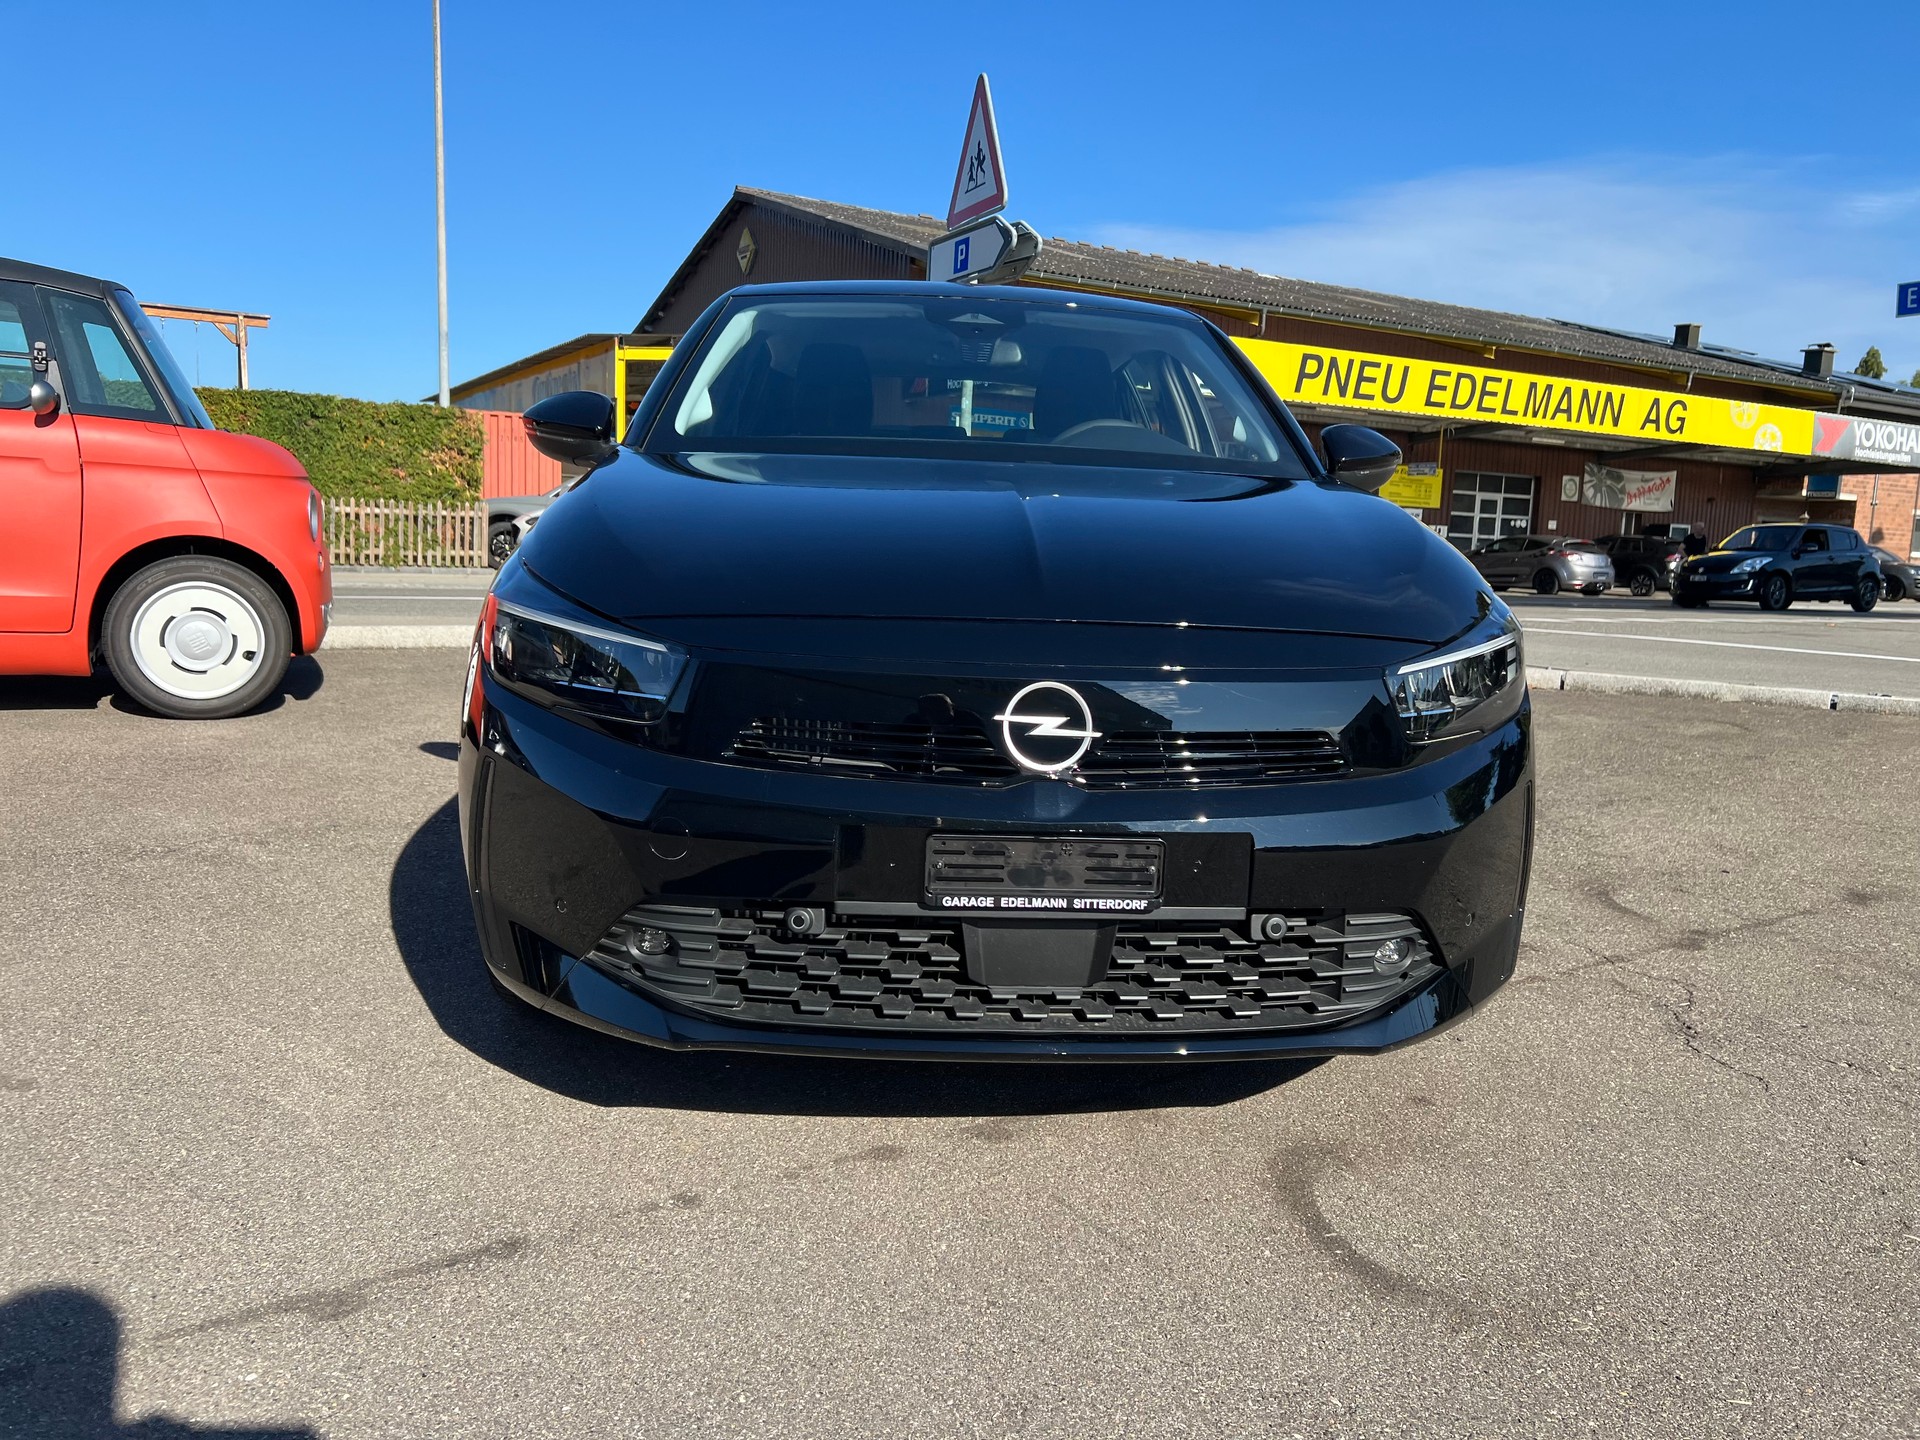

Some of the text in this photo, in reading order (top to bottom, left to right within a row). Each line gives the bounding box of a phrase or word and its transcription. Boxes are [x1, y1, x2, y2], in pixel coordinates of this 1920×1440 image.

[957, 243, 966, 270] P
[1294, 352, 1689, 435] PNEU EDELMANN AG
[951, 411, 1016, 427] SMPERIT
[188, 631, 212, 654] FIAT
[941, 896, 1149, 911] GARAGE EDELMANN SITTERDORF
